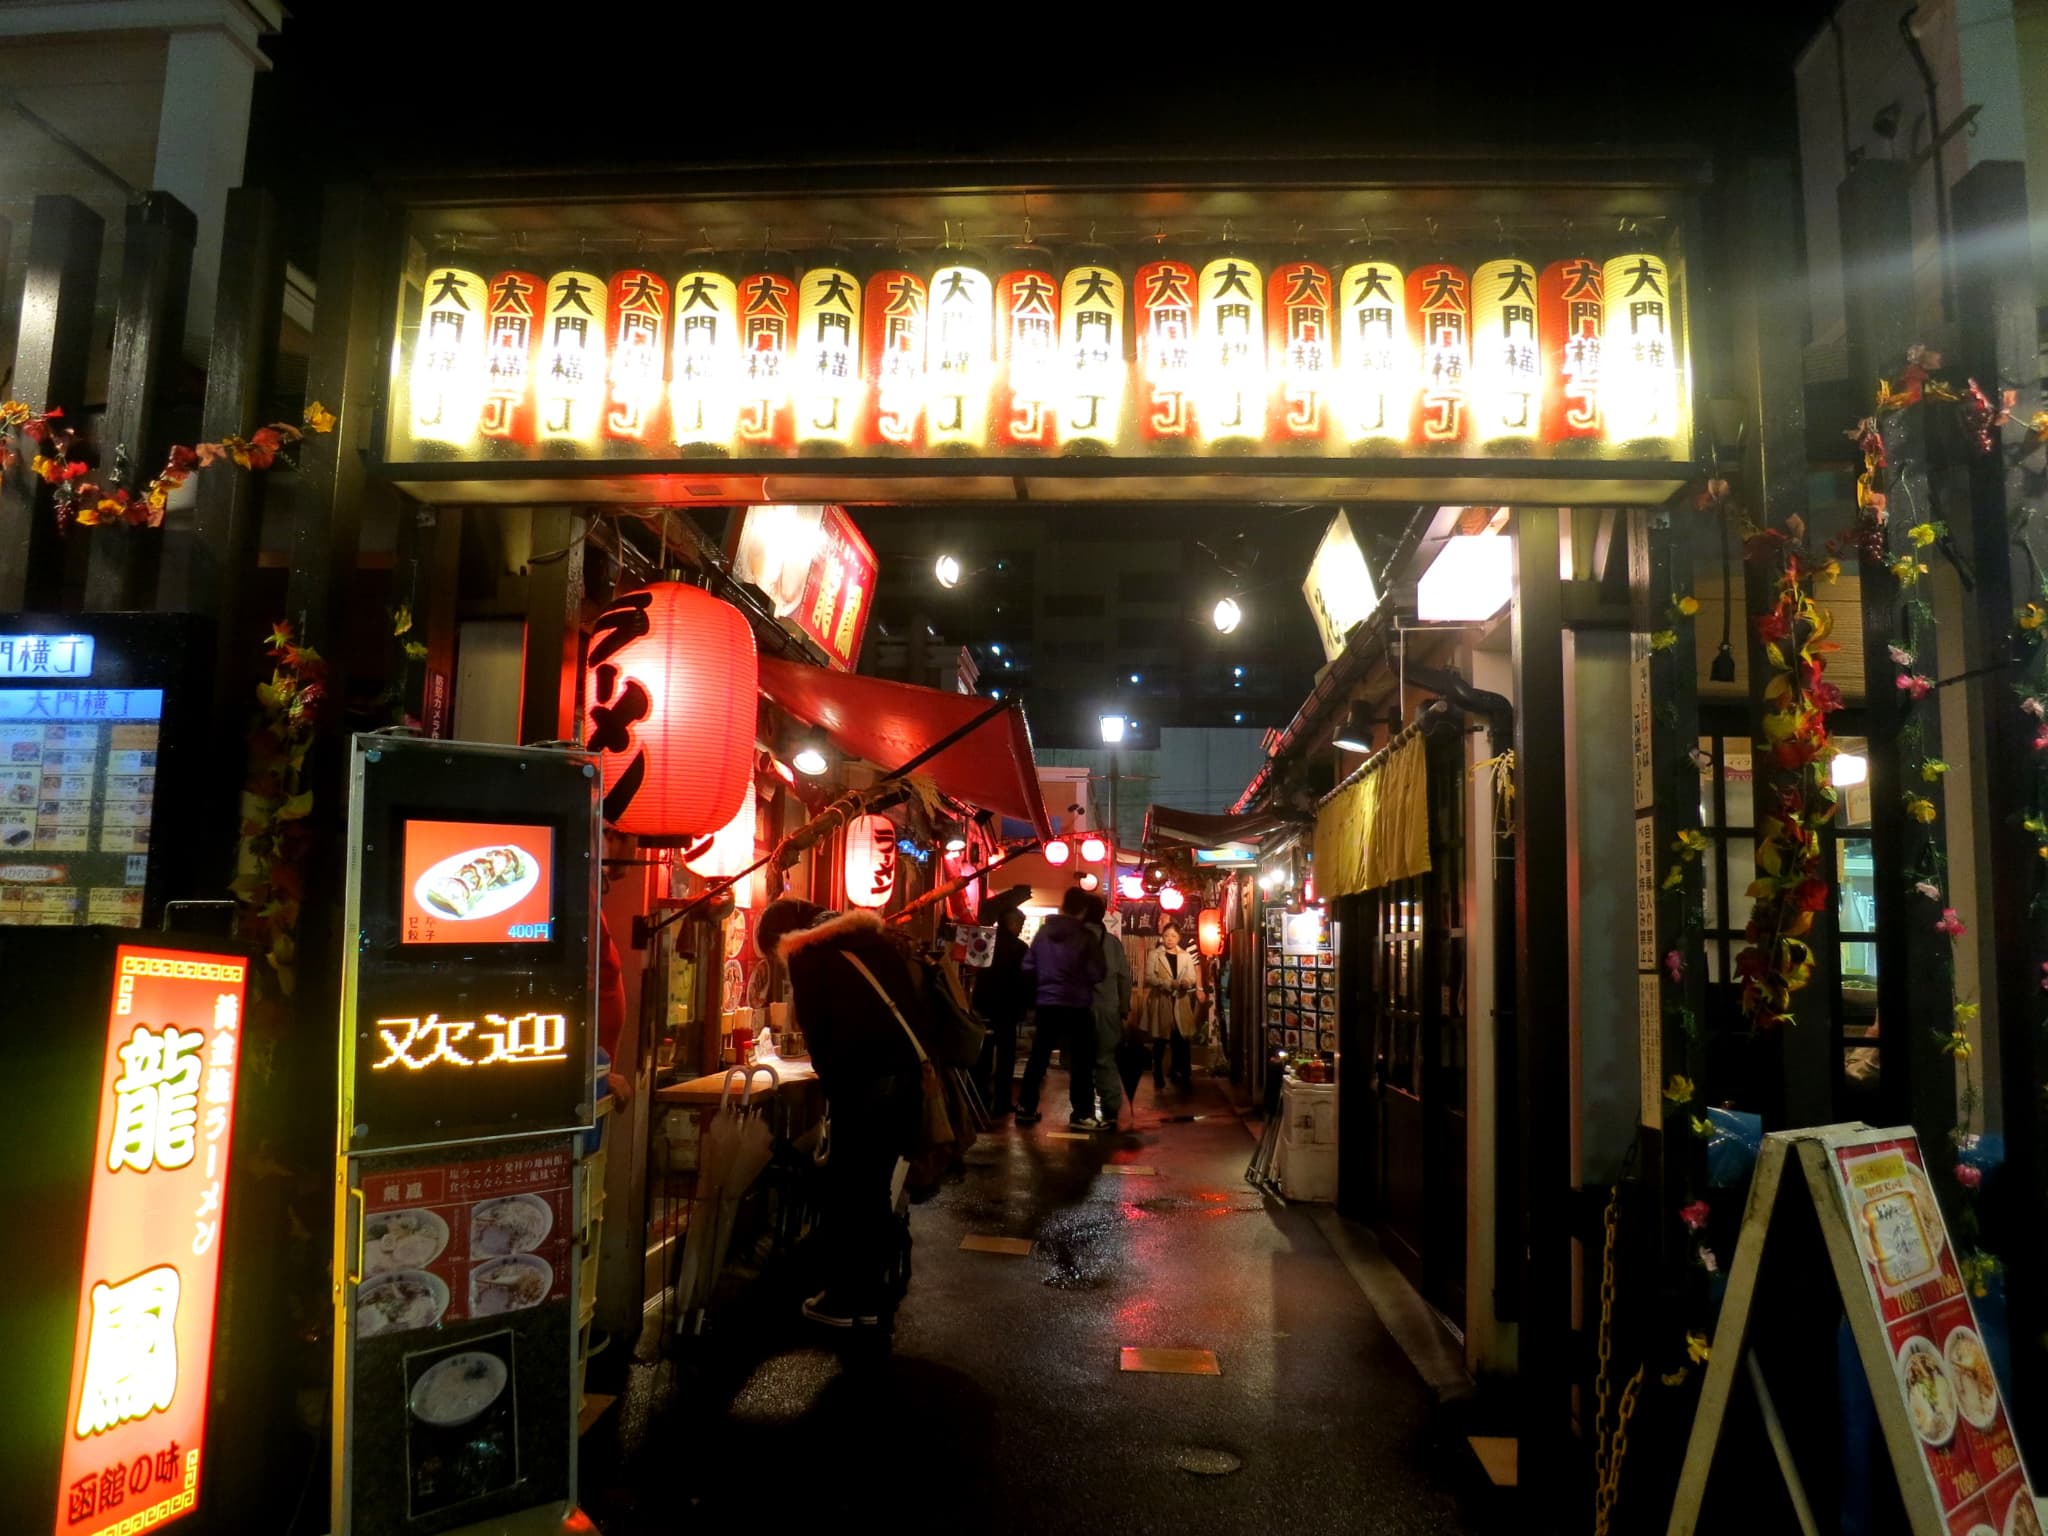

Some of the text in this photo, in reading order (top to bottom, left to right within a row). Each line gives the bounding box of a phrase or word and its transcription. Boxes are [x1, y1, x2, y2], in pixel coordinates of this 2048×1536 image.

[481, 276, 531, 434] 大門横丁
[546, 278, 593, 434] 大門横丁
[741, 276, 787, 437] 大門横丁
[813, 273, 855, 432] 大門横丁
[1010, 277, 1053, 437] 大門丁
[1287, 266, 1328, 433] 大門横丁
[1423, 271, 1464, 440] 大門横丁
[1497, 264, 1536, 429] 大門横丁
[25, 691, 135, 718] 大門横丁
[508, 923, 548, 940] 400円
[373, 1013, 568, 1070] 欢迎
[76, 1024, 204, 1439] 龍鳳
[67, 1441, 181, 1527] 函館の味
